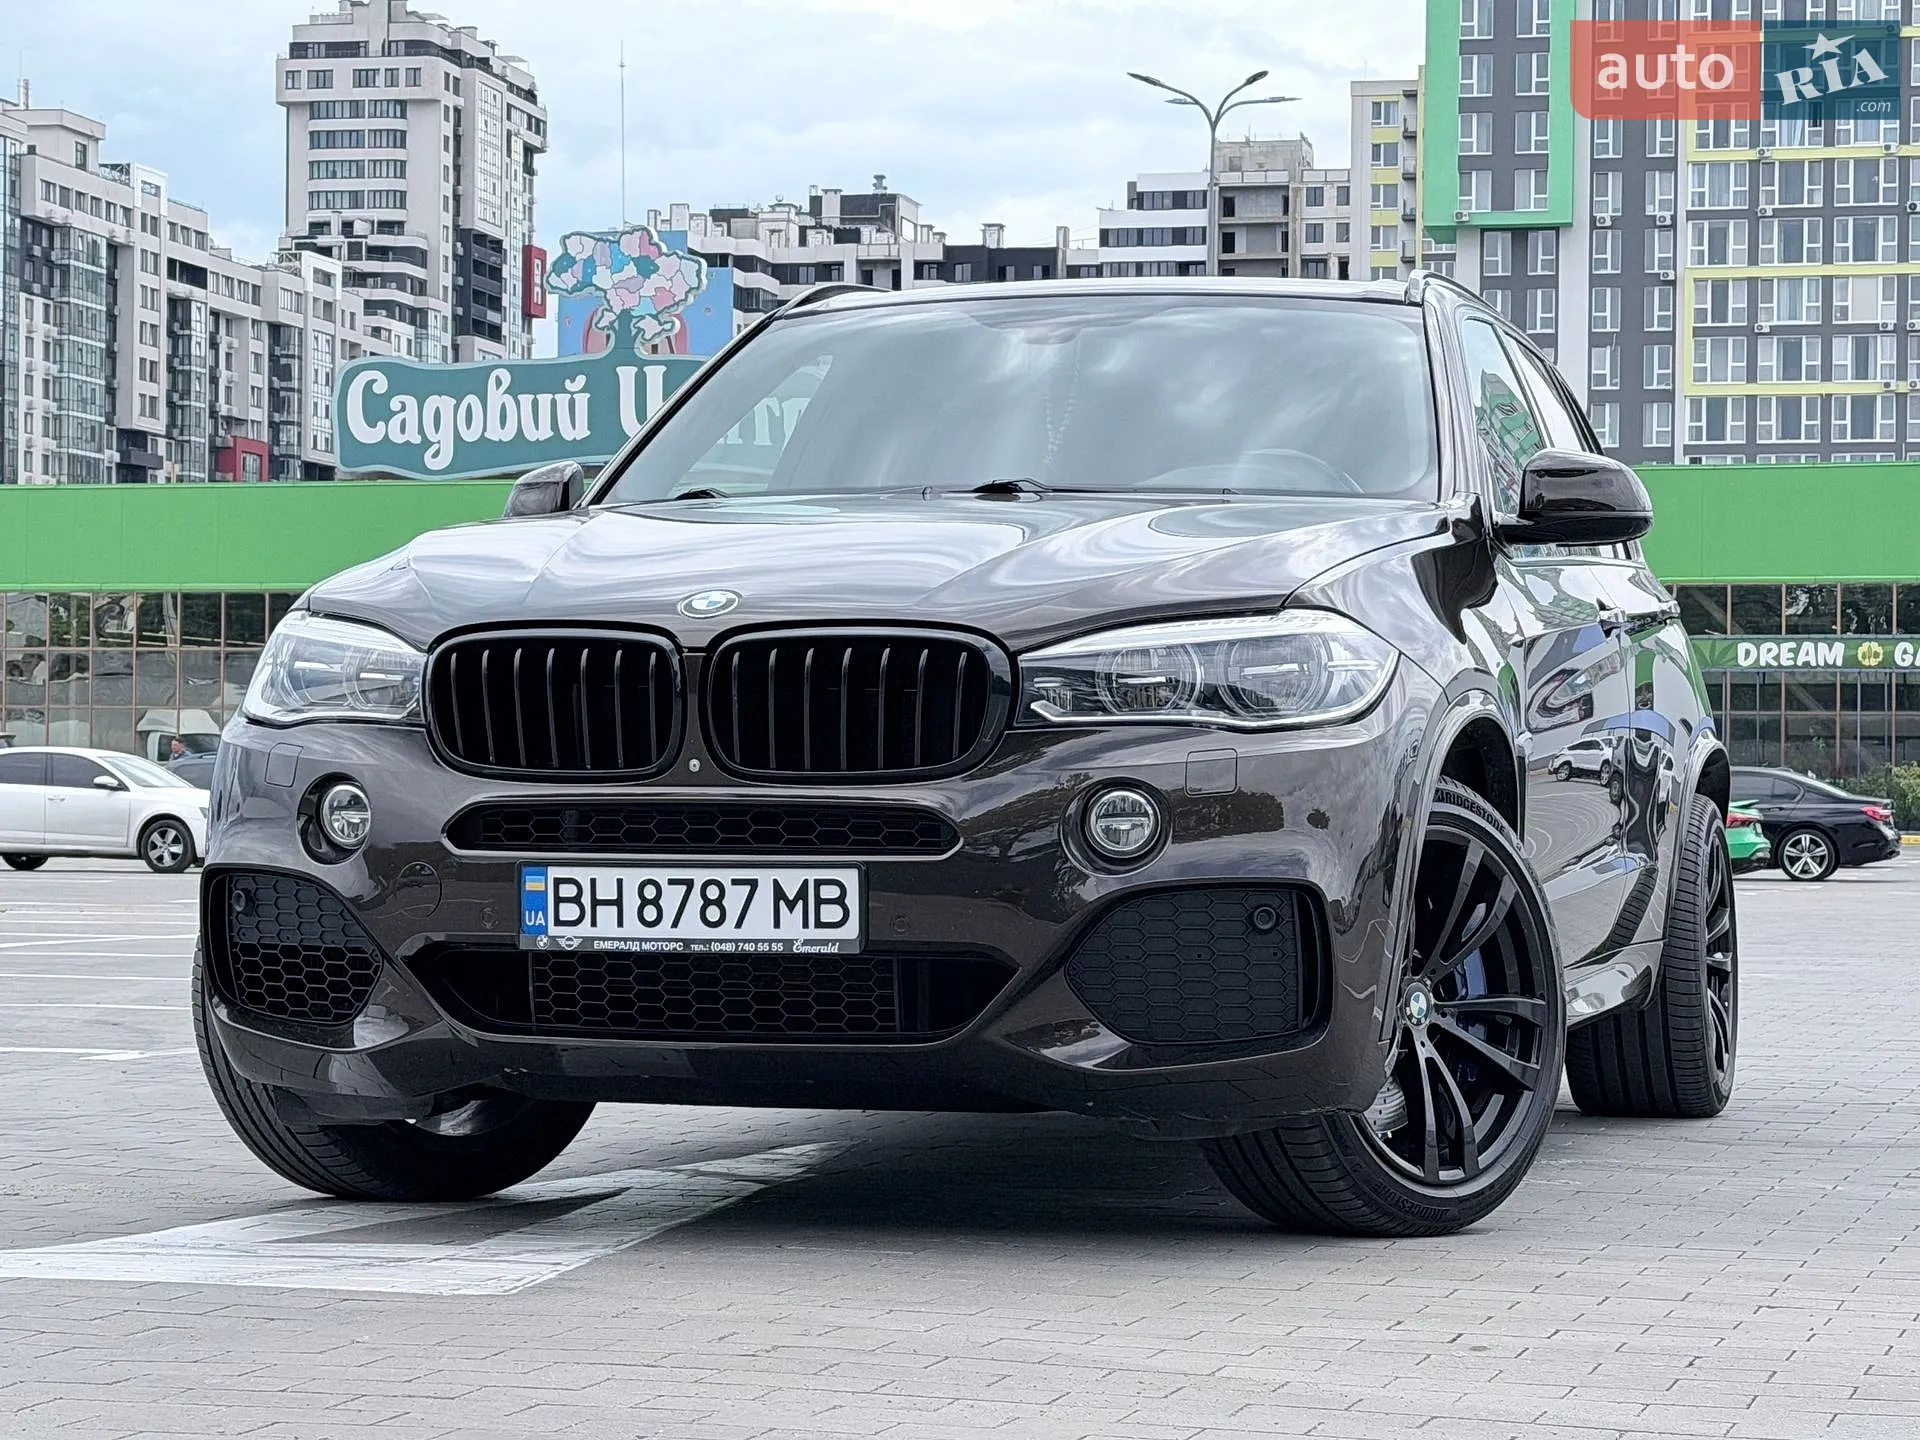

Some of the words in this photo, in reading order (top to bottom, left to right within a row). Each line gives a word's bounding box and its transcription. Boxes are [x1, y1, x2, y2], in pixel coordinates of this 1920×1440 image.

[347, 369, 591, 471] Садовий
[1737, 641, 1845, 667] DREAM
[552, 876, 624, 929] BH
[636, 877, 759, 929] 8787
[772, 877, 850, 930] MB
[525, 909, 546, 926] UA
[594, 940, 640, 952] ЕМЕРАЛД
[641, 941, 684, 951] МОТОРС
[710, 941, 735, 952] (048)
[737, 942, 755, 952] 740
[757, 942, 769, 952] 55
[771, 942, 784, 952] 55
[792, 937, 840, 953] Emerald
